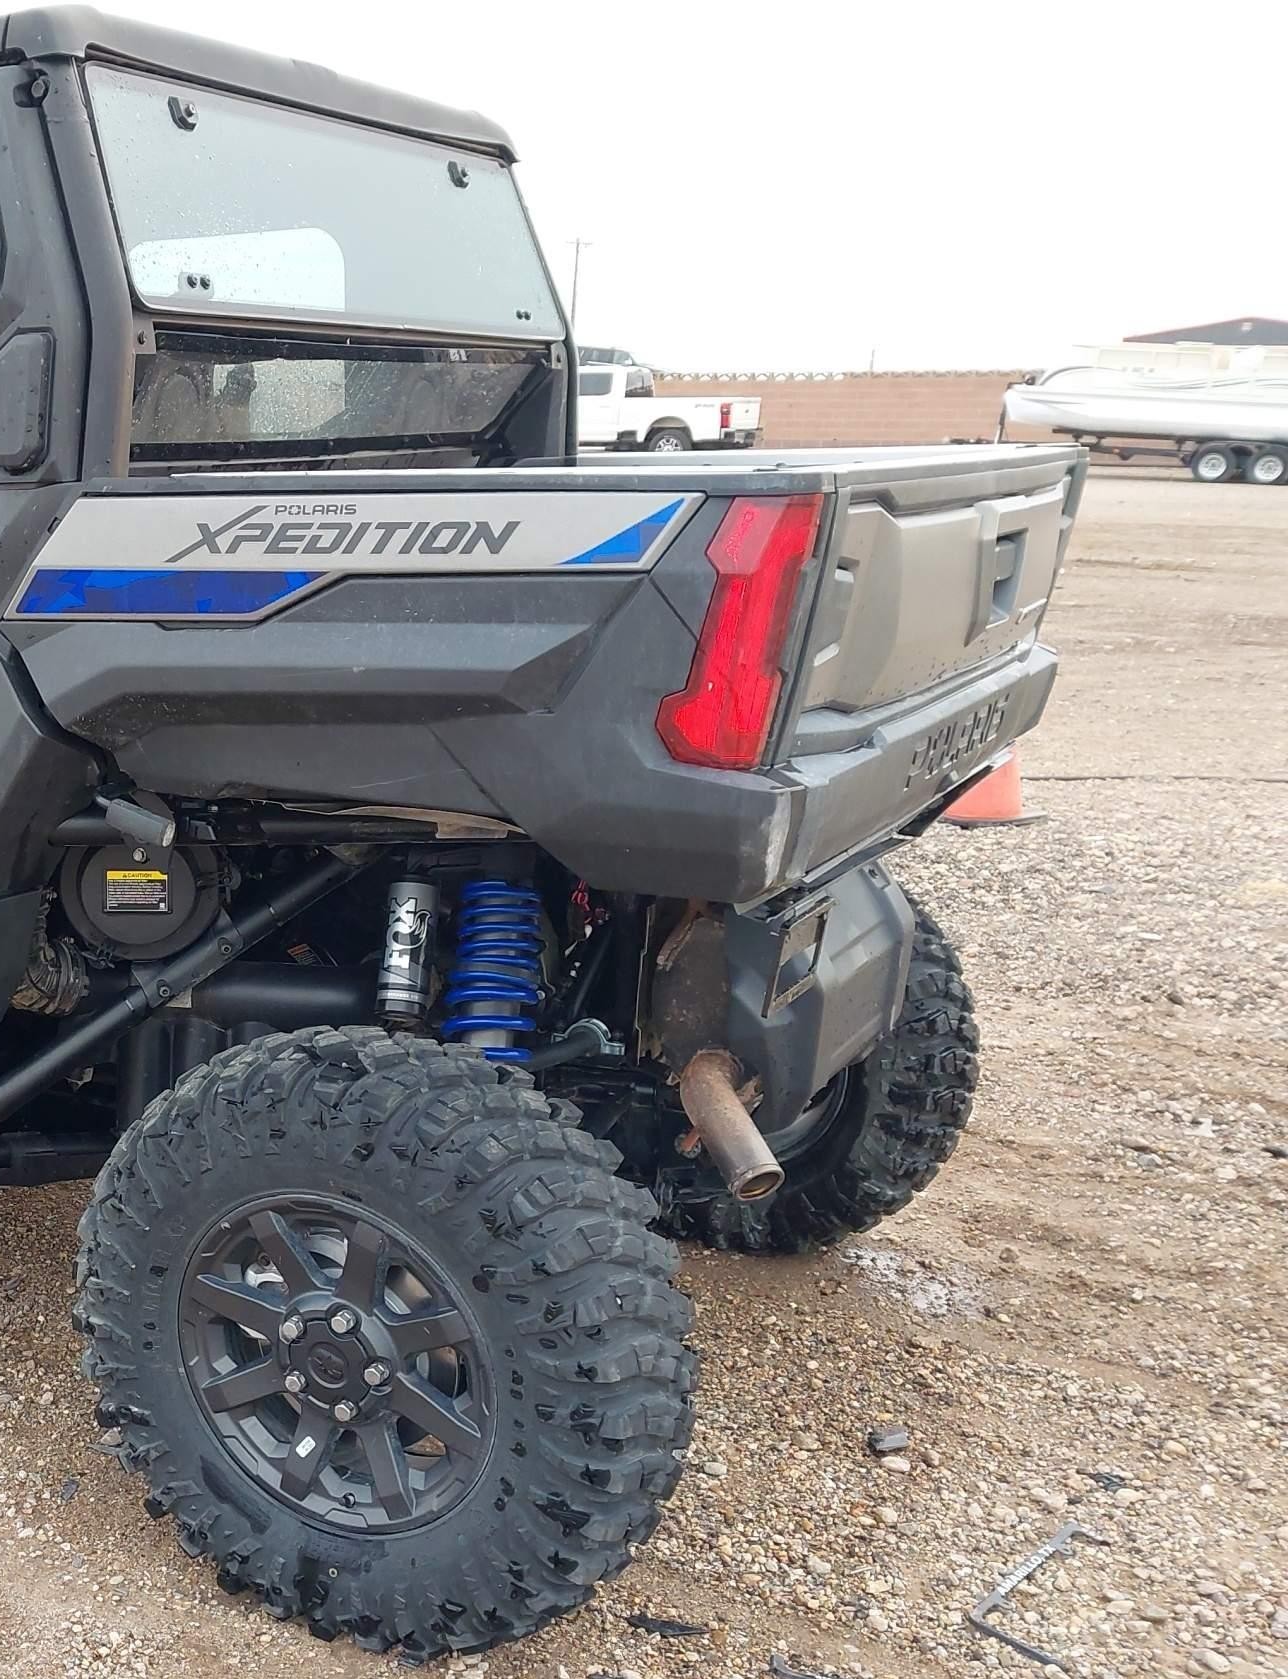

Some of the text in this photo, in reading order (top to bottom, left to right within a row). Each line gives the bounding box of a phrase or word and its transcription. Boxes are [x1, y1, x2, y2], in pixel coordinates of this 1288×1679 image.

[163, 505, 521, 563] XPEDITION
[274, 504, 357, 516] POLARIS
[384, 897, 431, 969] FOX
